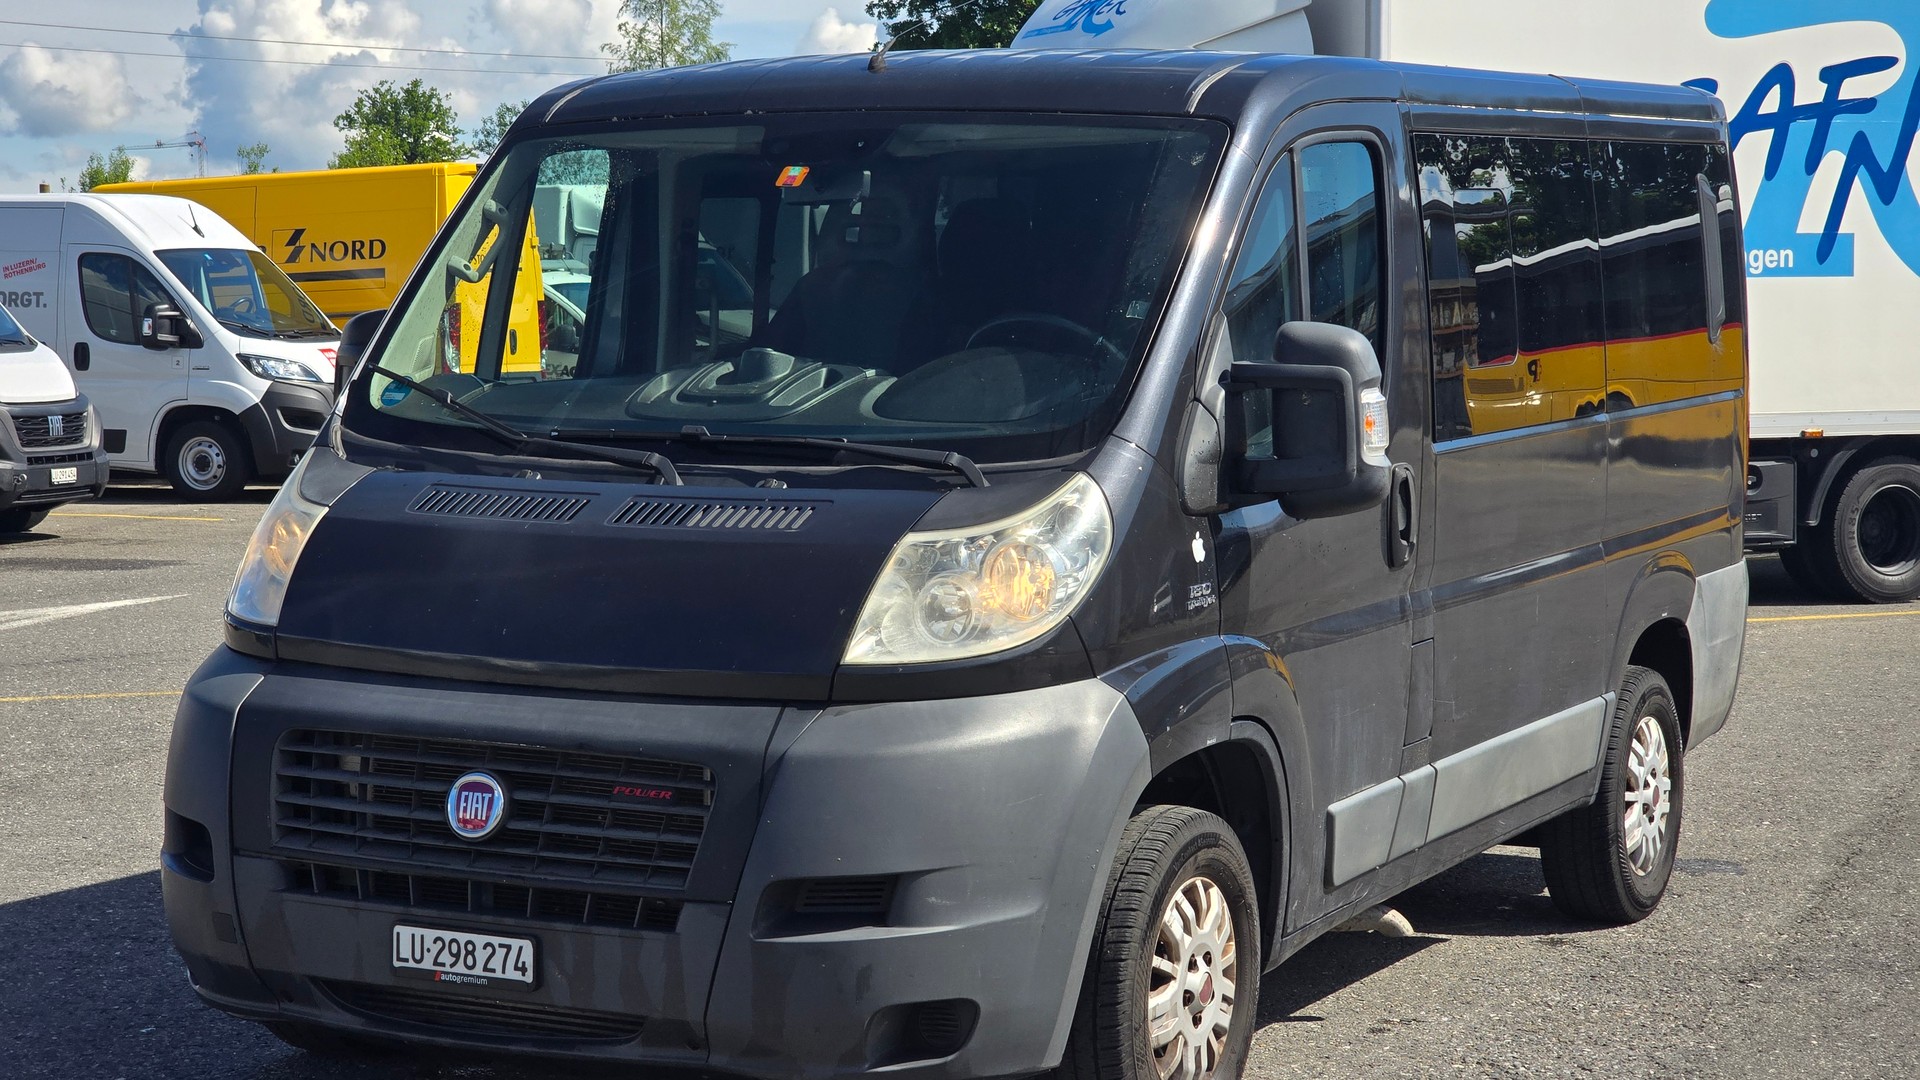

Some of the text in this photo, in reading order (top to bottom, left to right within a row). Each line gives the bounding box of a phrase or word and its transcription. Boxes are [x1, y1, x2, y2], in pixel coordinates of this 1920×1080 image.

[310, 239, 387, 262] NORD
[4, 263, 46, 279] ROTHENBURG
[1745, 249, 1793, 274] gen
[48, 416, 64, 436] FIAT
[612, 785, 673, 800] POWER
[459, 791, 492, 820] FIAT
[440, 973, 488, 985] autogremium
